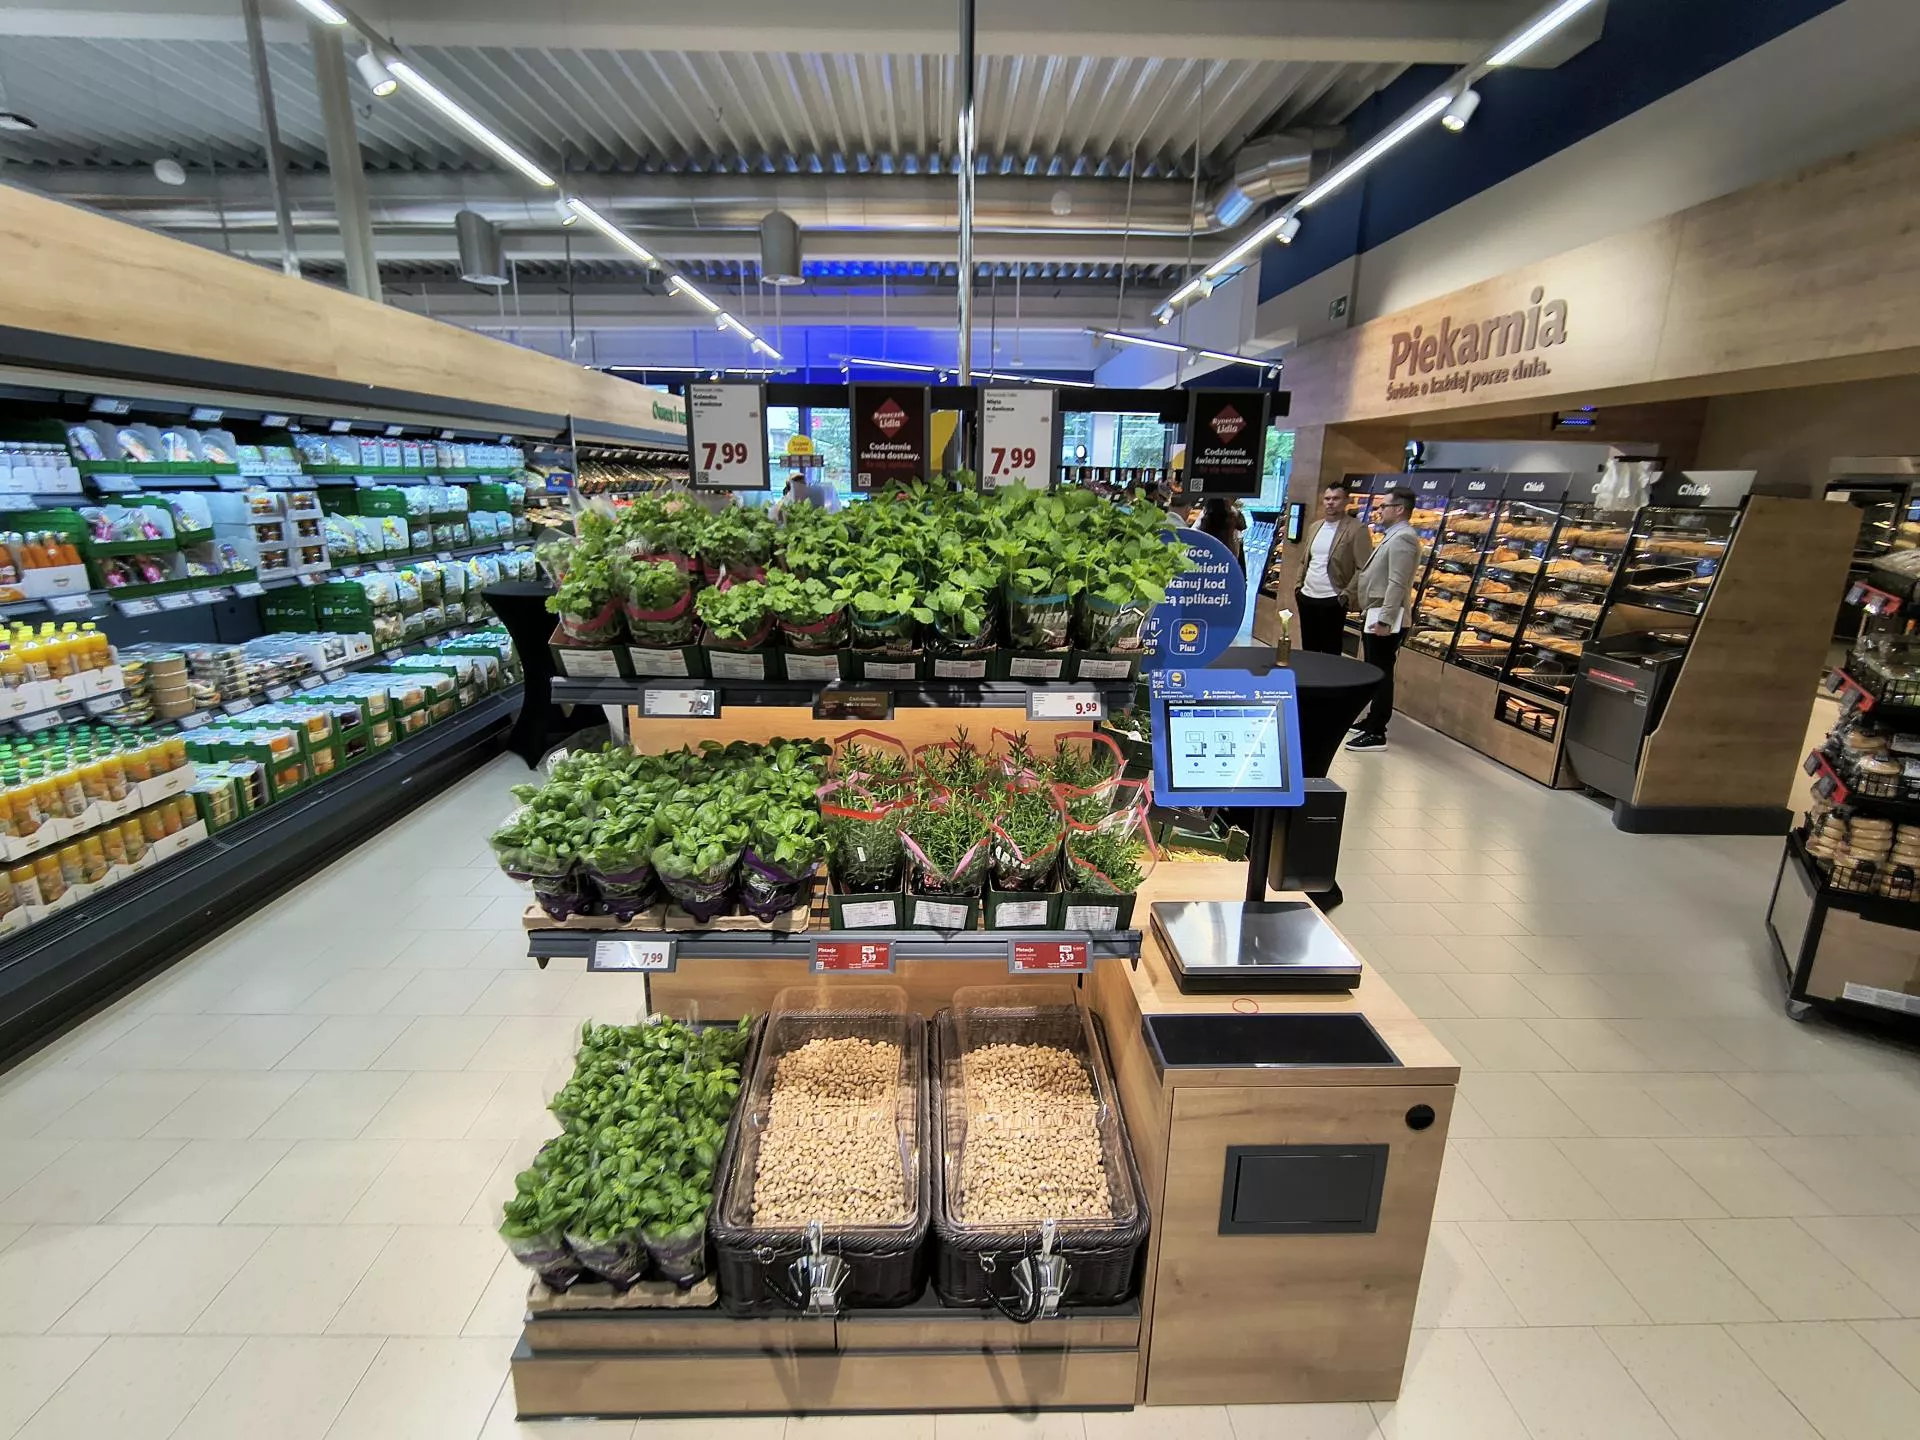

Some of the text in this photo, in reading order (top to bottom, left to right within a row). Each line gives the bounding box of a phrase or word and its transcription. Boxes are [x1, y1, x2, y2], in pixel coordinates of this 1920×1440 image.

[1388, 285, 1568, 380] Piekarnia
[1421, 384, 1428, 395] o
[1430, 370, 1470, 394] każdej
[1470, 367, 1509, 393] porze
[1512, 356, 1552, 381] dnia.
[880, 419, 901, 428] Lidla
[1217, 425, 1238, 434] Lidla
[869, 442, 912, 451] Codziennie
[702, 442, 748, 470] 7.99
[1204, 448, 1246, 456] Codziennie
[991, 447, 1036, 475] 7.99
[1523, 481, 1545, 492] Chleb
[1678, 484, 1711, 496] Chleb
[1183, 549, 1213, 559] woce,
[1166, 578, 1226, 591] kanuj kod
[1179, 593, 1232, 607] aplikacji.
[1180, 644, 1196, 652] Plus
[1153, 690, 1161, 698] 1.
[1203, 690, 1211, 699] 2.
[1254, 690, 1262, 699] 3.
[1076, 703, 1097, 714] 9.99
[641, 953, 663, 966] 7.99
[1060, 953, 1074, 963] 5.39
